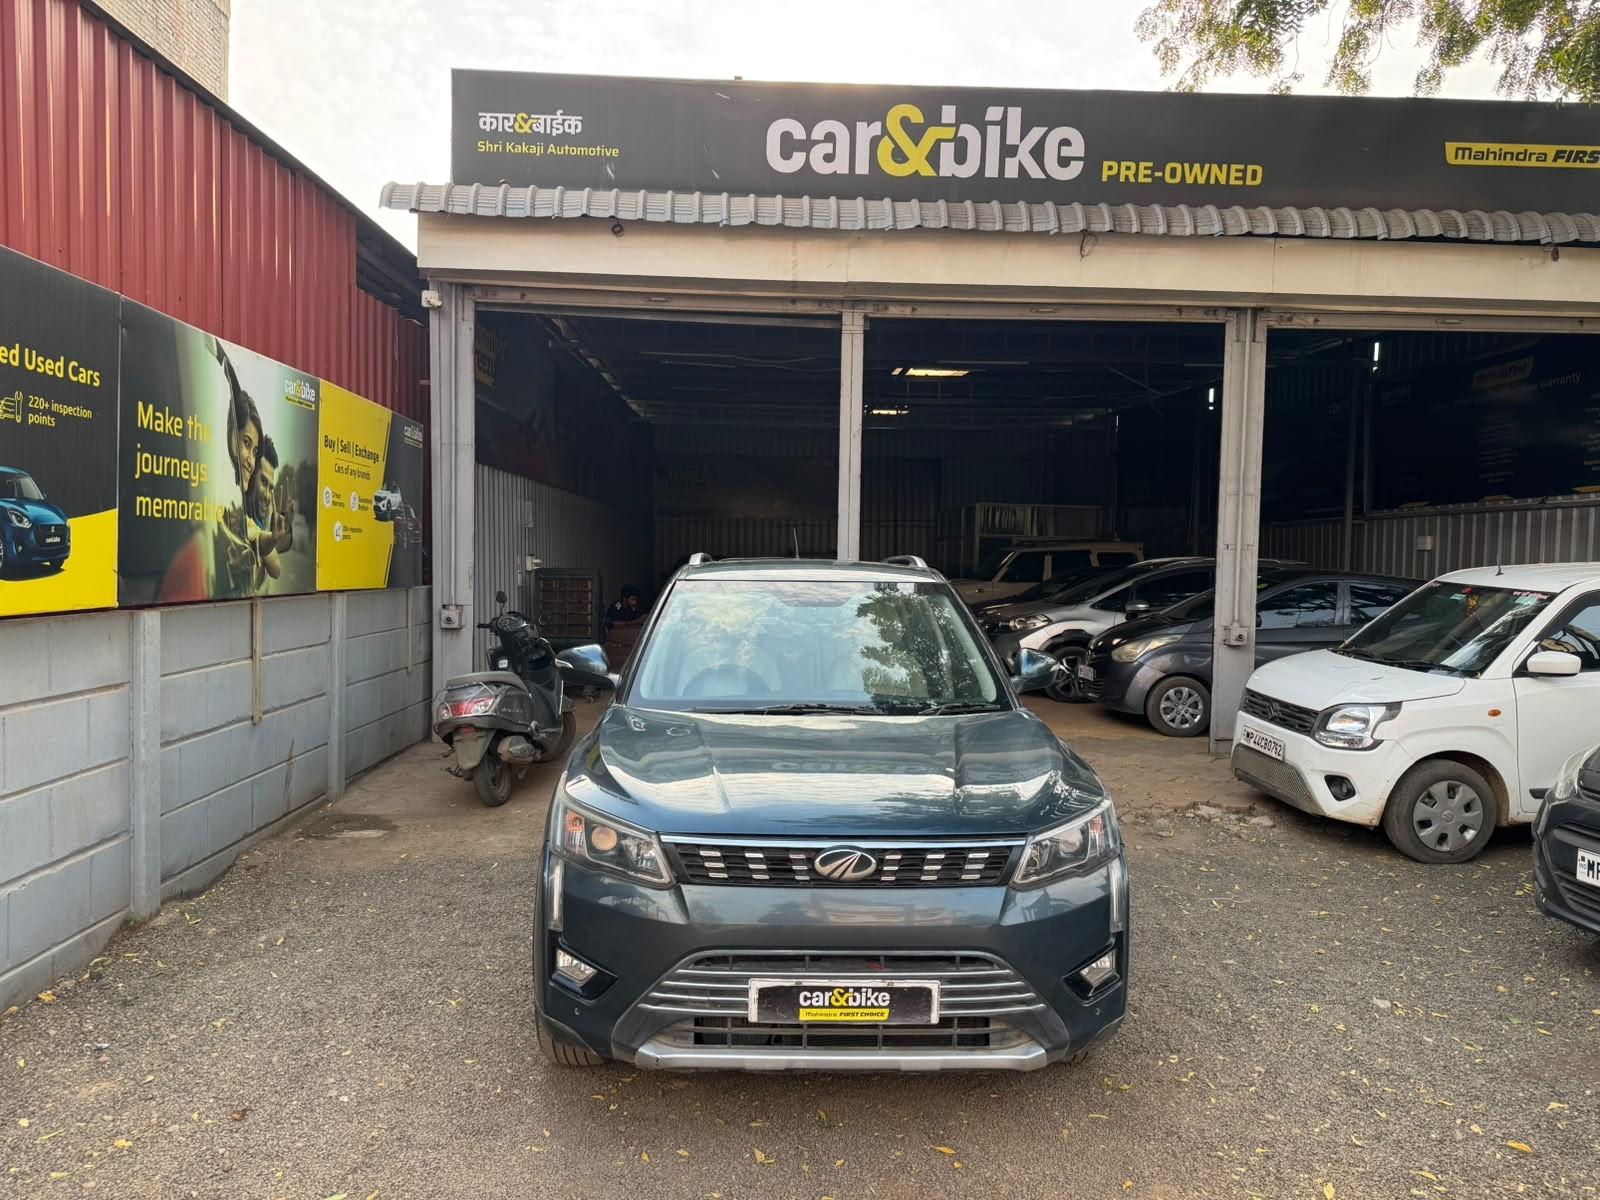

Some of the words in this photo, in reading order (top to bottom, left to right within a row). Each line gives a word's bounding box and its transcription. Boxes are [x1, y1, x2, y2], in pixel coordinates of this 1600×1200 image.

[477, 141, 502, 152] Shri
[506, 142, 544, 156] Kakaji
[547, 143, 620, 157] Automotive
[766, 103, 1085, 181] car&bike
[1454, 147, 1548, 162] Mahindra
[1101, 160, 1263, 186] PRE-OWNED
[24, 348, 65, 378] Used
[68, 360, 101, 387] Cars
[28, 395, 50, 410] 220+
[51, 400, 93, 419] inspection
[28, 412, 56, 427] points
[137, 400, 183, 437] Make
[324, 435, 336, 452] Buy
[340, 440, 351, 454] Sell
[355, 444, 380, 464] Exchange
[135, 443, 208, 488] journeys
[799, 987, 891, 1007] car&bike
